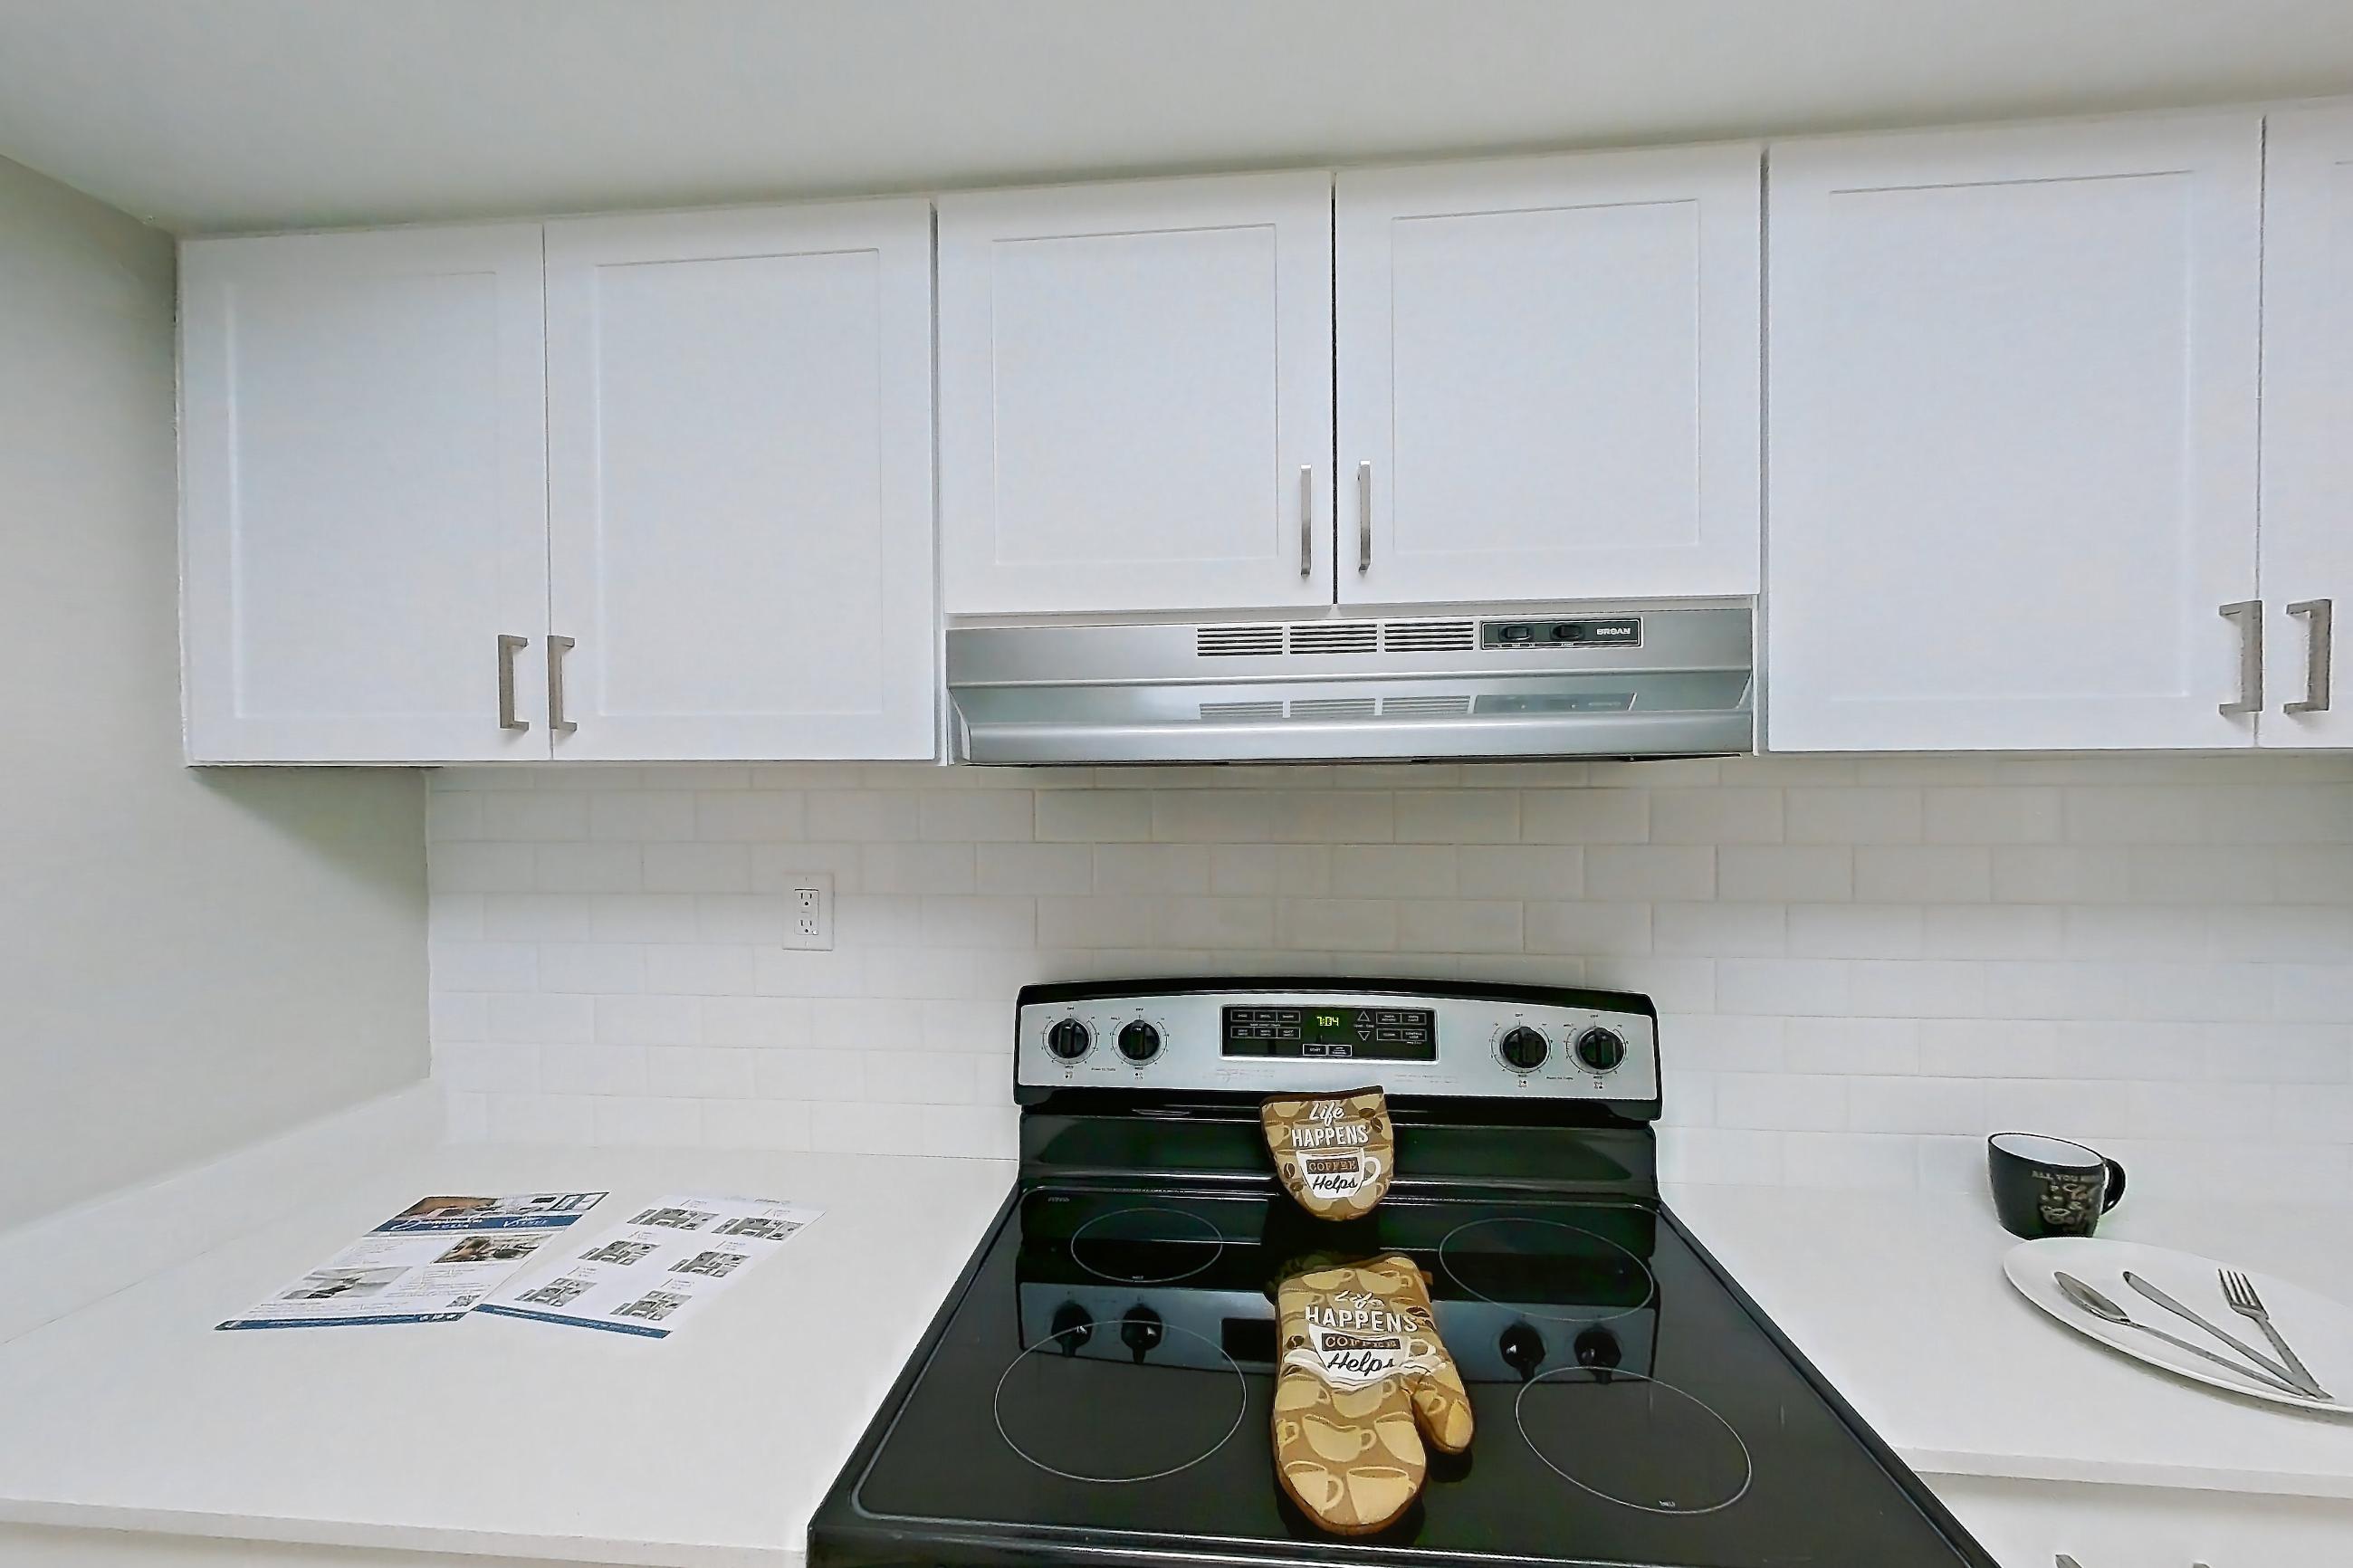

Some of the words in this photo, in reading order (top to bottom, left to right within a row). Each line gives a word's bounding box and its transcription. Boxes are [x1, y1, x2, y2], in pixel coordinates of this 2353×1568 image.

[1596, 627, 1631, 636] BROAN
[1316, 1016, 1339, 1027] 7:04
[1309, 1101, 1345, 1126] Life
[1291, 1125, 1370, 1147] HAPPENS
[1308, 1160, 1357, 1171] COFFEE
[1313, 1175, 1358, 1193] Helps
[1305, 1305, 1419, 1334] HAPPENS
[1327, 1351, 1395, 1376] Helps
